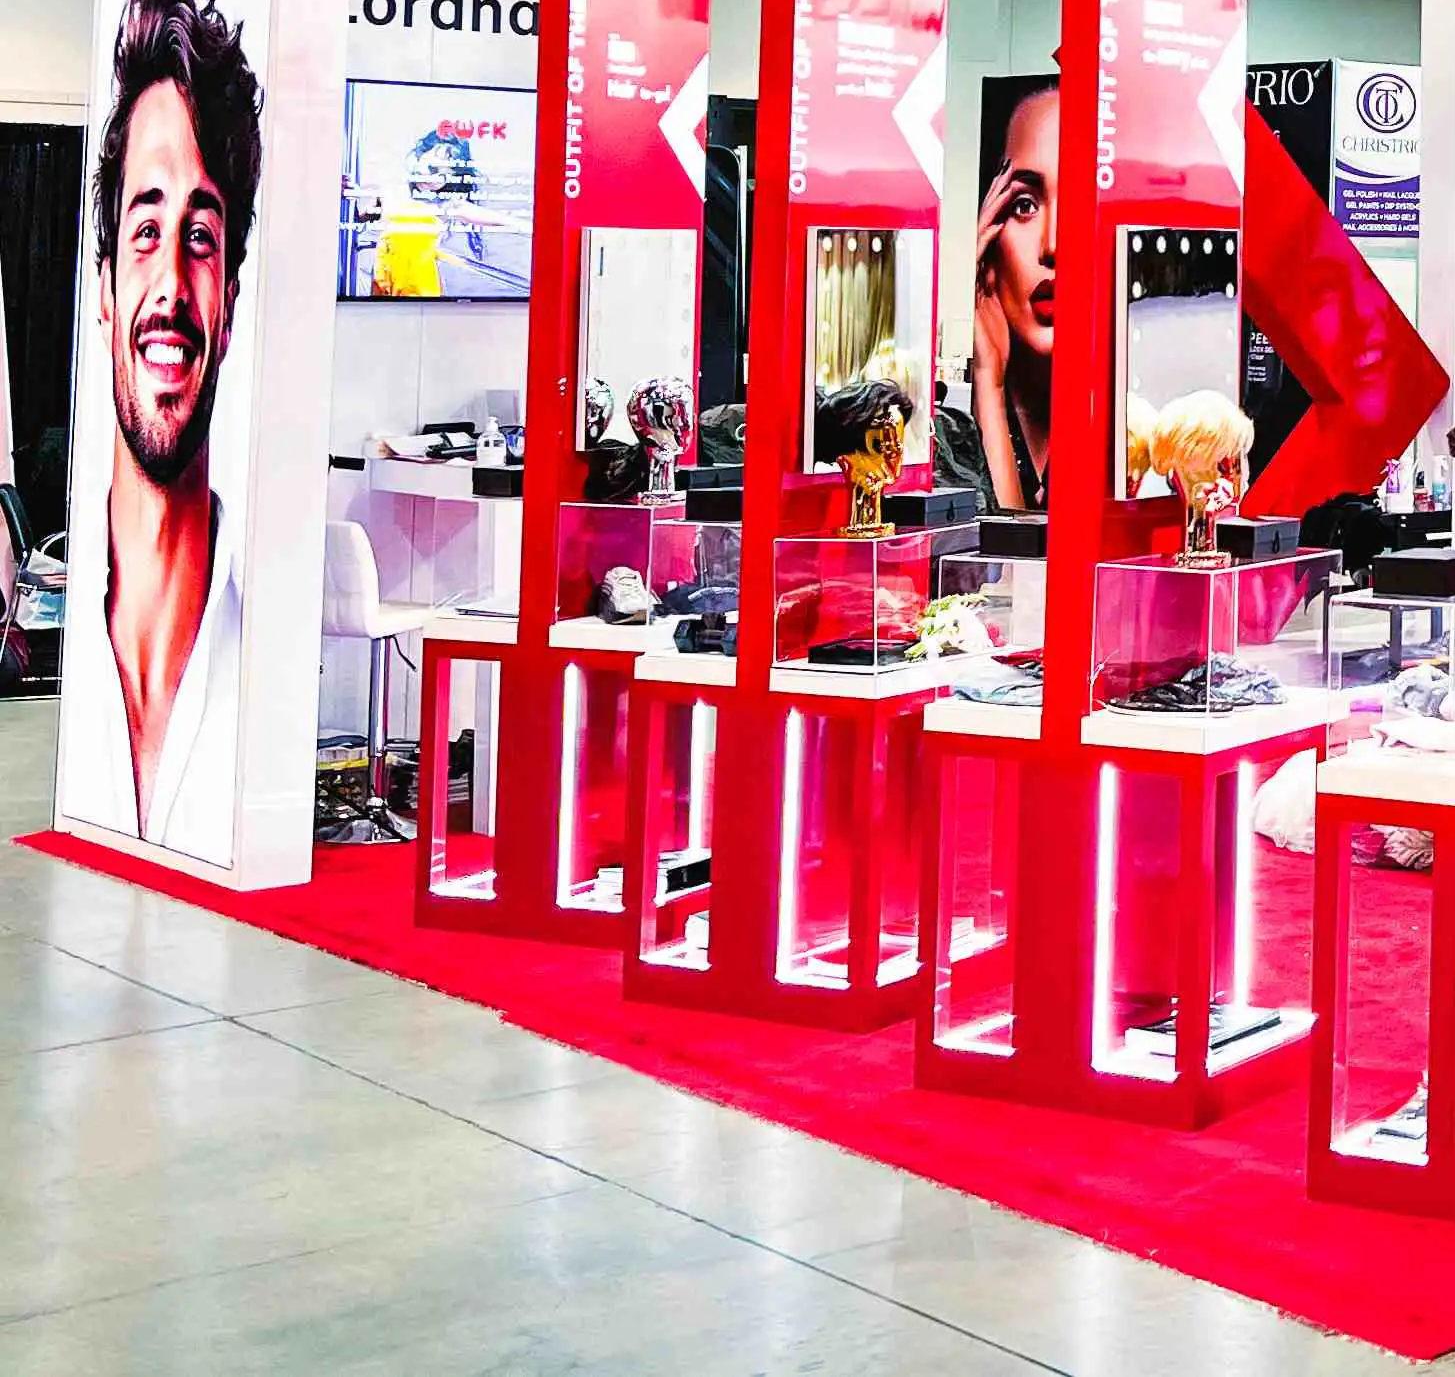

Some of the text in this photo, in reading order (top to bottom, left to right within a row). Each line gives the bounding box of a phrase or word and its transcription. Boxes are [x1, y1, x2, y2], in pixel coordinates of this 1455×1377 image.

[568, 55, 586, 94] OF
[1099, 16, 1119, 63] OF
[564, 100, 584, 199] OUTFIT
[788, 86, 811, 195] OUTFIT
[1096, 69, 1118, 190] OUTFIT
